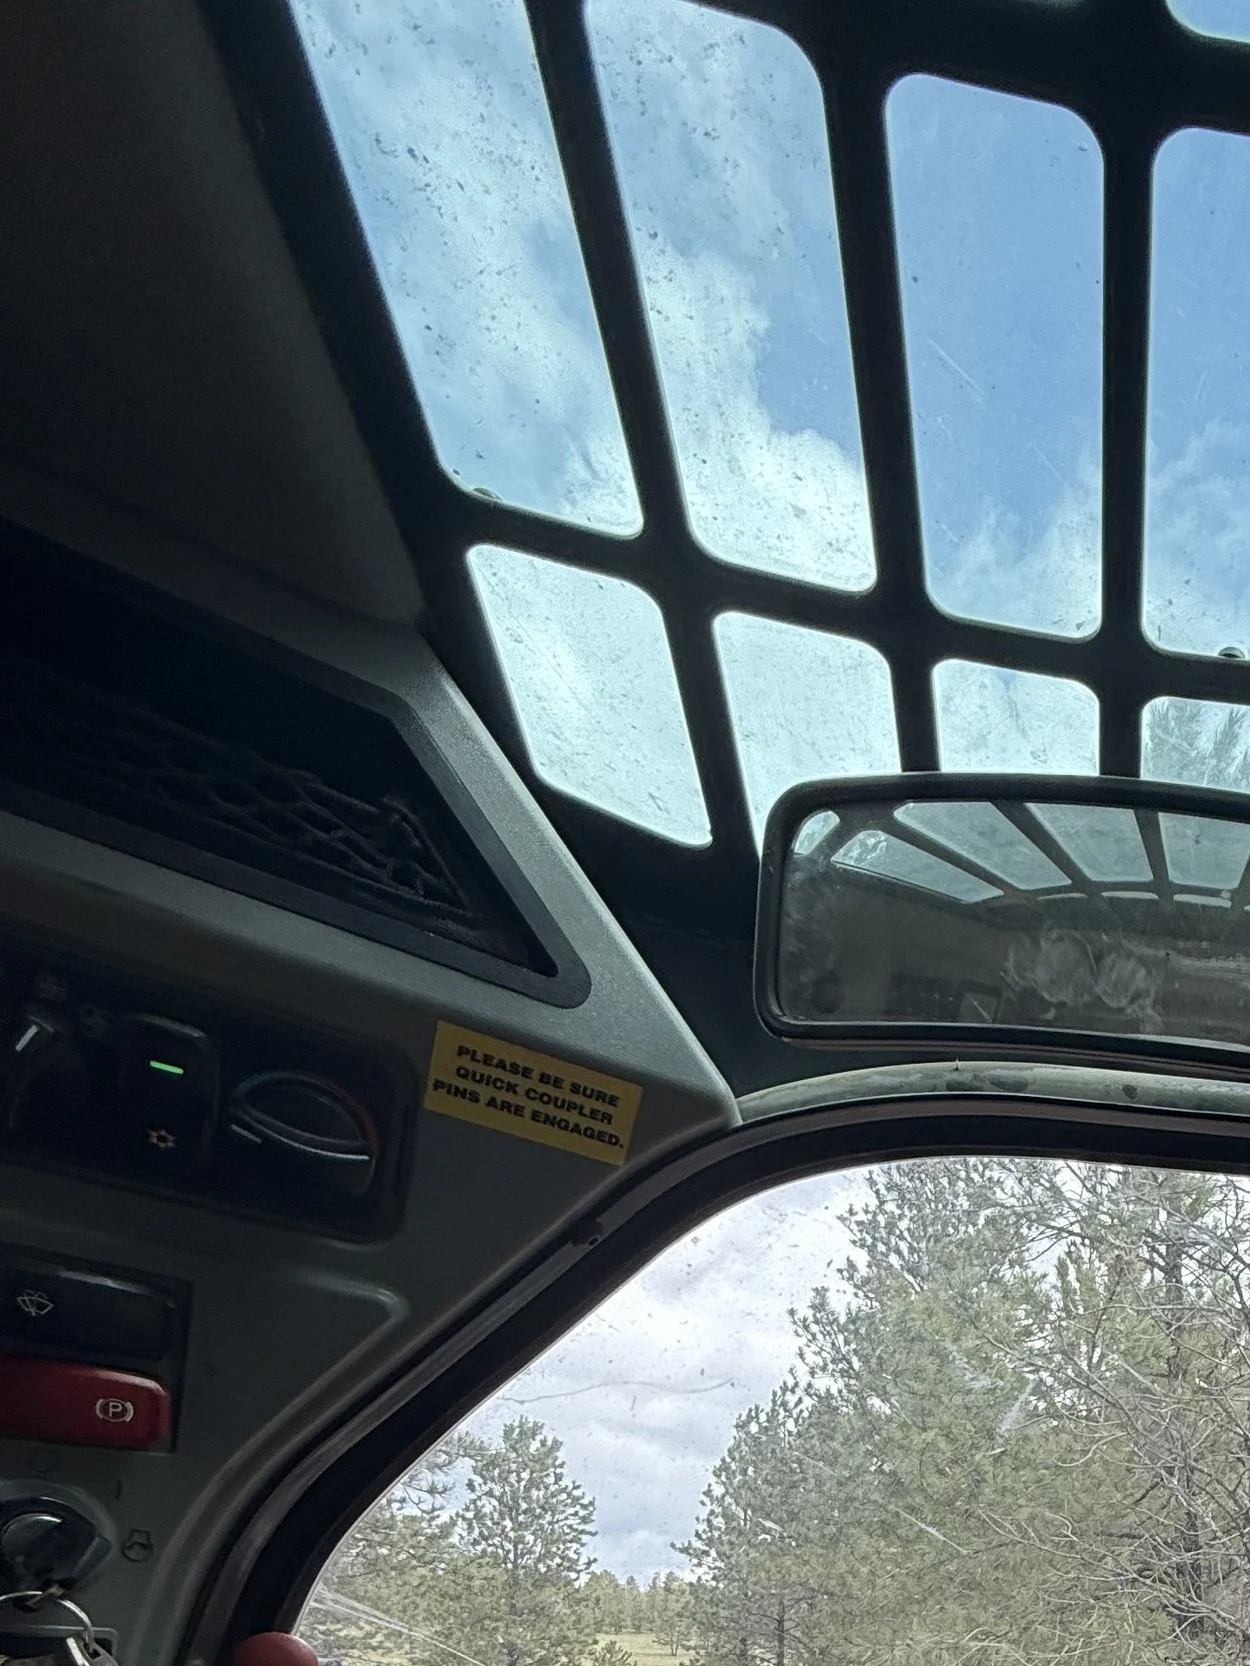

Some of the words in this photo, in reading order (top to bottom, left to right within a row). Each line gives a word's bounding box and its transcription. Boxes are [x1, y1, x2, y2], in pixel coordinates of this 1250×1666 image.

[455, 1066, 520, 1095] QUICK
[525, 1088, 613, 1125] COUPLER
[456, 1045, 533, 1080] PLEASE
[538, 1073, 565, 1090] BE
[570, 1082, 620, 1108] SURE
[432, 1079, 481, 1104] PINS
[485, 1096, 526, 1117] ARE
[531, 1110, 624, 1148] ENGAGED.
